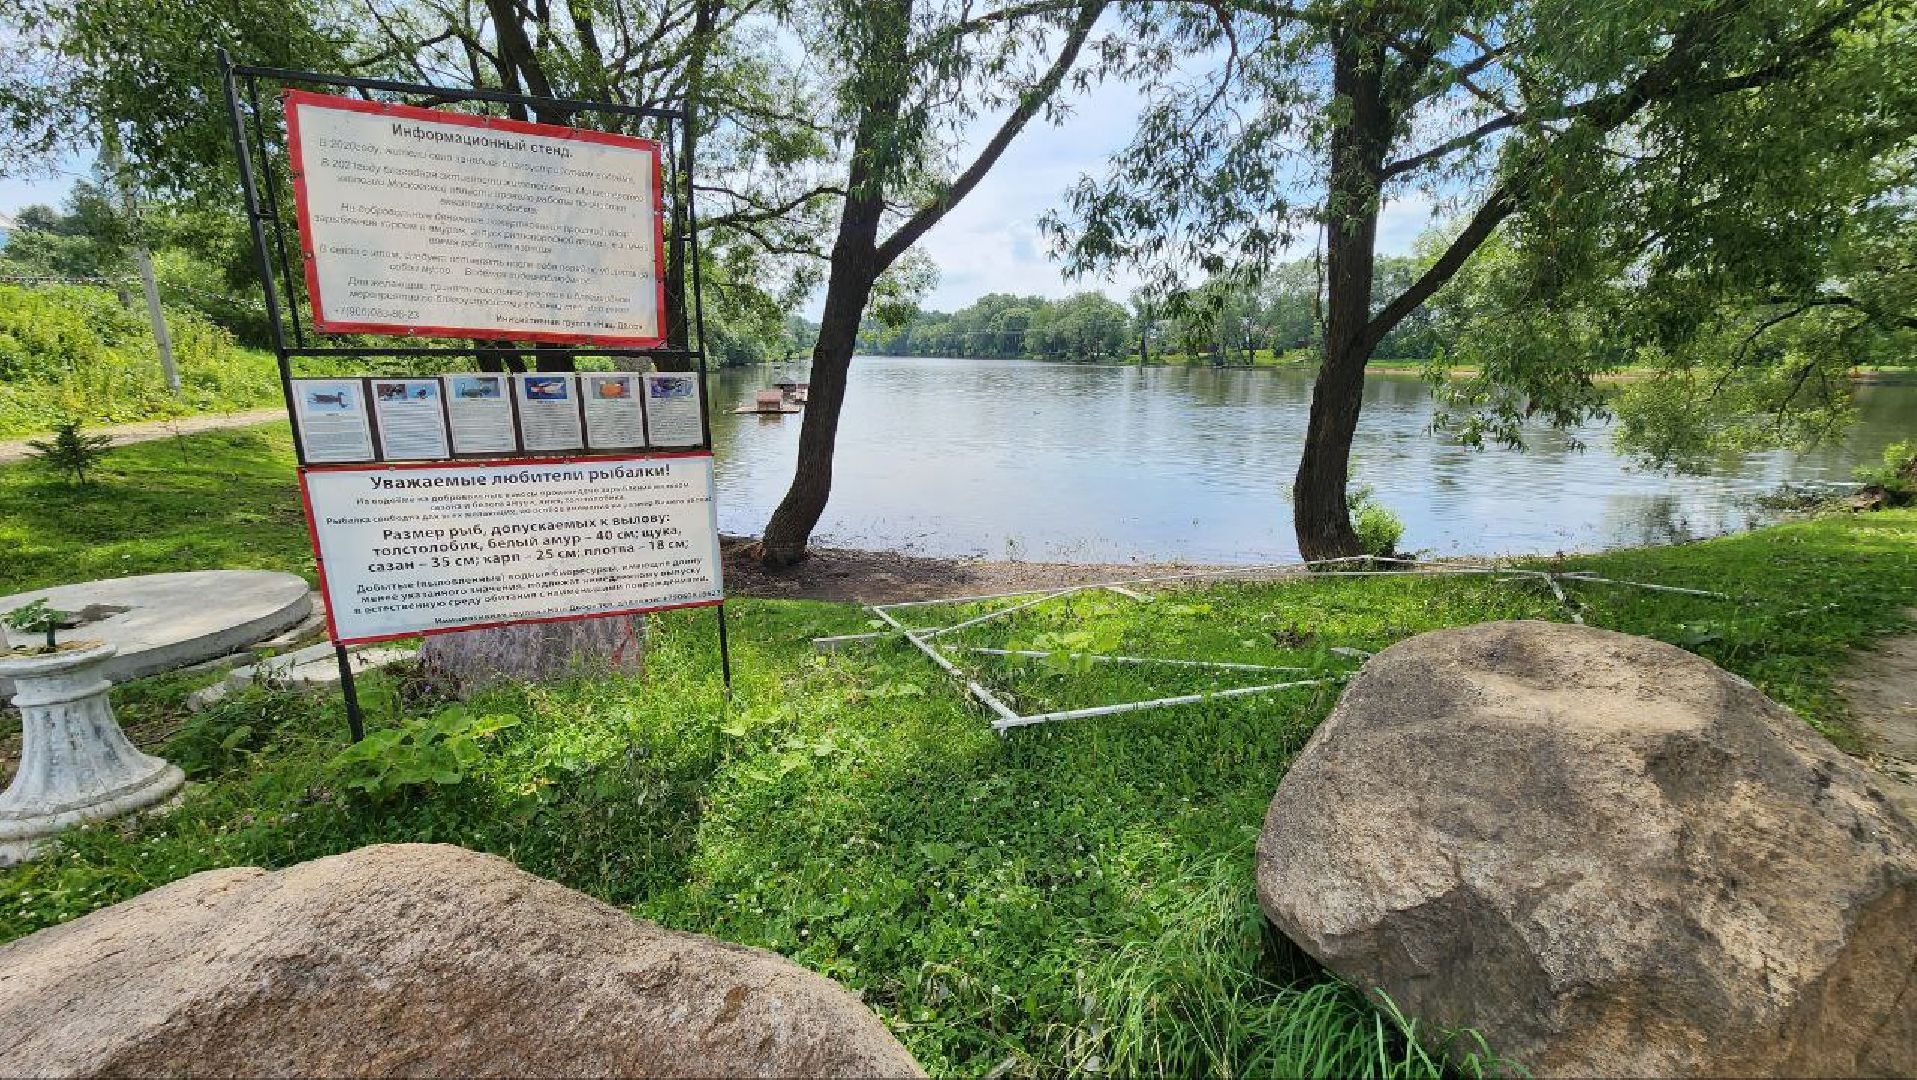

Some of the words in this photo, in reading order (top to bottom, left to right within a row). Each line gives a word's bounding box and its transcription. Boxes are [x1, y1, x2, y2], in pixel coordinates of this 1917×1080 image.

[392, 123, 526, 153] Информационный
[530, 141, 573, 159] стенд.
[369, 471, 487, 490] Уважаемые
[489, 467, 583, 483] любители
[588, 462, 671, 482] рыбалки!
[382, 526, 445, 543] Размер
[447, 523, 487, 538] рыб,
[489, 518, 597, 536] допускаемых
[600, 517, 608, 526] к
[612, 514, 670, 528] вылову:
[367, 560, 414, 572] сазан
[429, 555, 450, 568] 35
[454, 555, 480, 567] см;
[482, 552, 521, 567] карп
[535, 547, 553, 561] 25
[556, 548, 580, 559] см;
[583, 544, 634, 556] плотва
[648, 539, 665, 551] 18
[667, 540, 689, 551] см;
[371, 539, 483, 559] толстолобик,
[486, 534, 538, 550] белый
[541, 534, 582, 547] амур
[594, 529, 613, 541] 40
[616, 530, 639, 542] см;
[641, 527, 682, 540] щука,
[671, 558, 702, 568] длину
[360, 594, 399, 604] менее
[399, 588, 468, 602] указанного
[363, 600, 447, 615] естественную
[447, 597, 481, 608] среду
[483, 591, 537, 603] обитания
